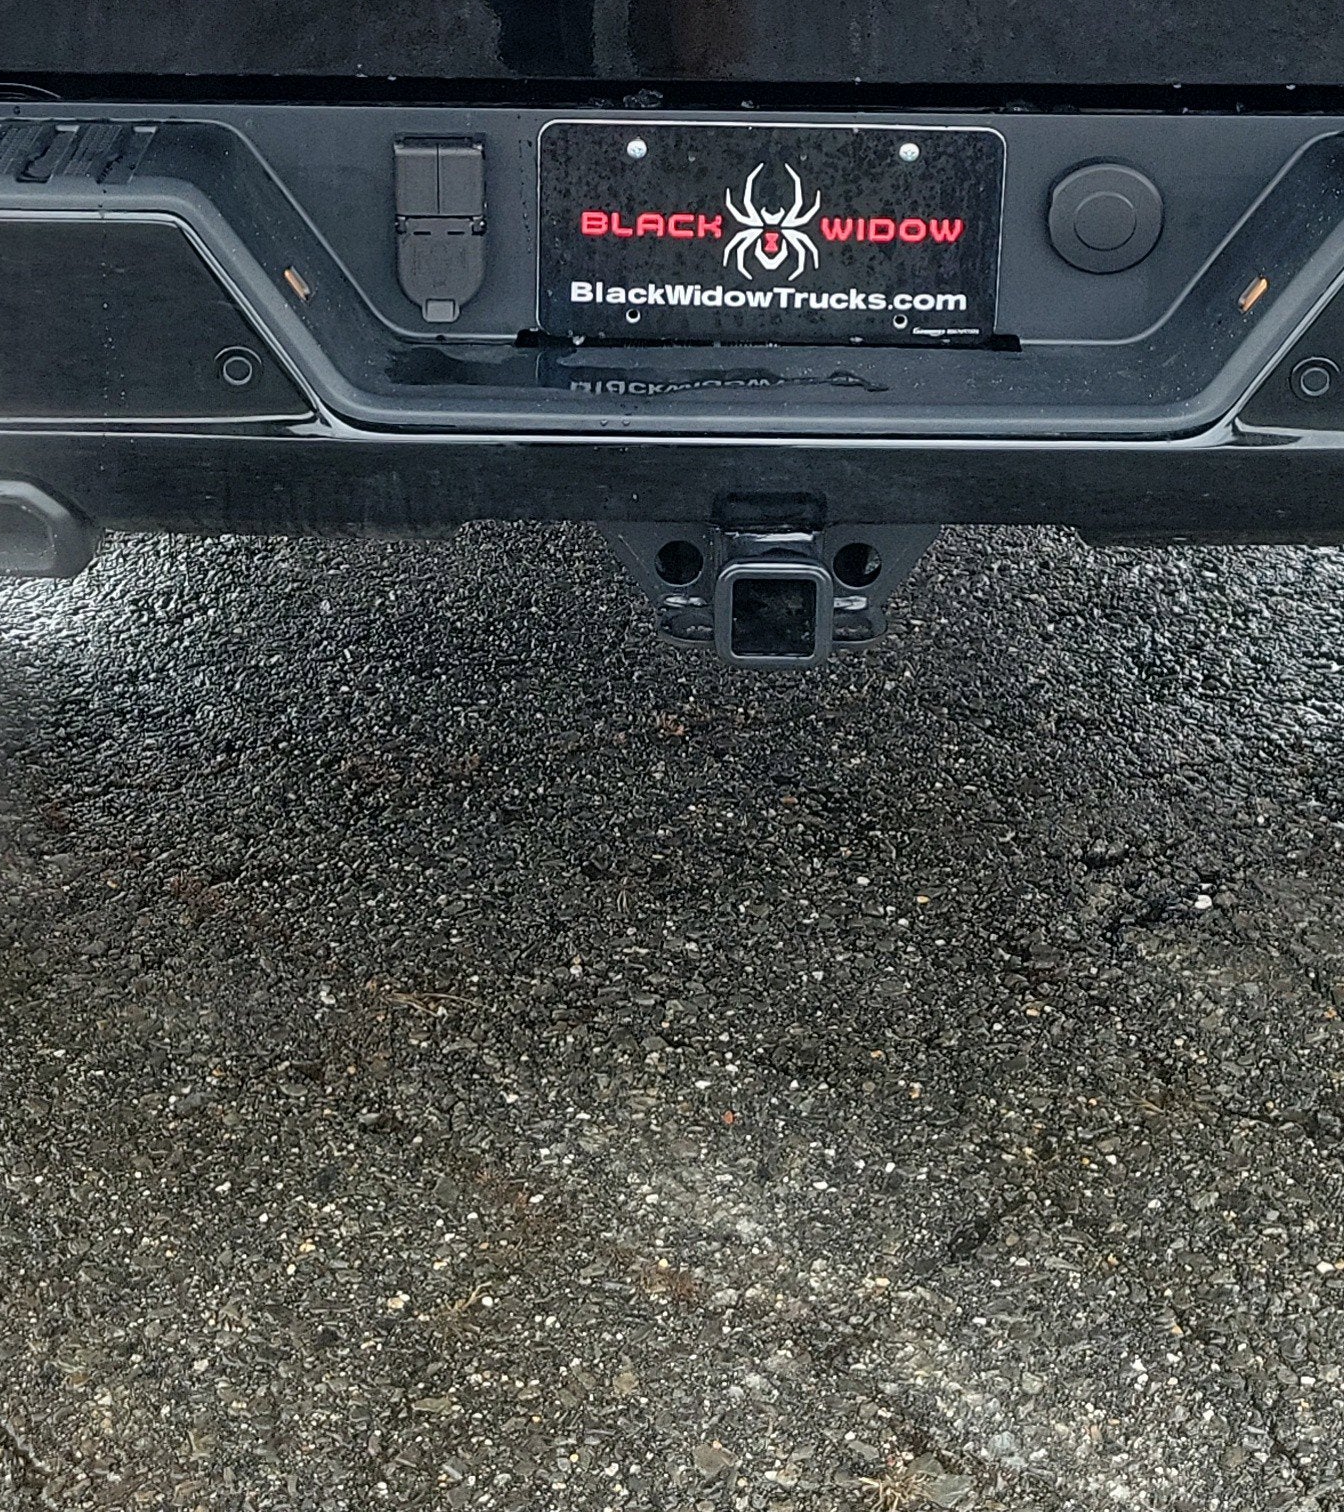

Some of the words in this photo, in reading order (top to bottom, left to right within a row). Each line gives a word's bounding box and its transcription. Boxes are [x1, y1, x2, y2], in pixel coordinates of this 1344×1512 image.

[580, 211, 722, 239] BLACK
[820, 217, 964, 243] WIDOW
[570, 281, 967, 311] BlackWidowTrucks.com
